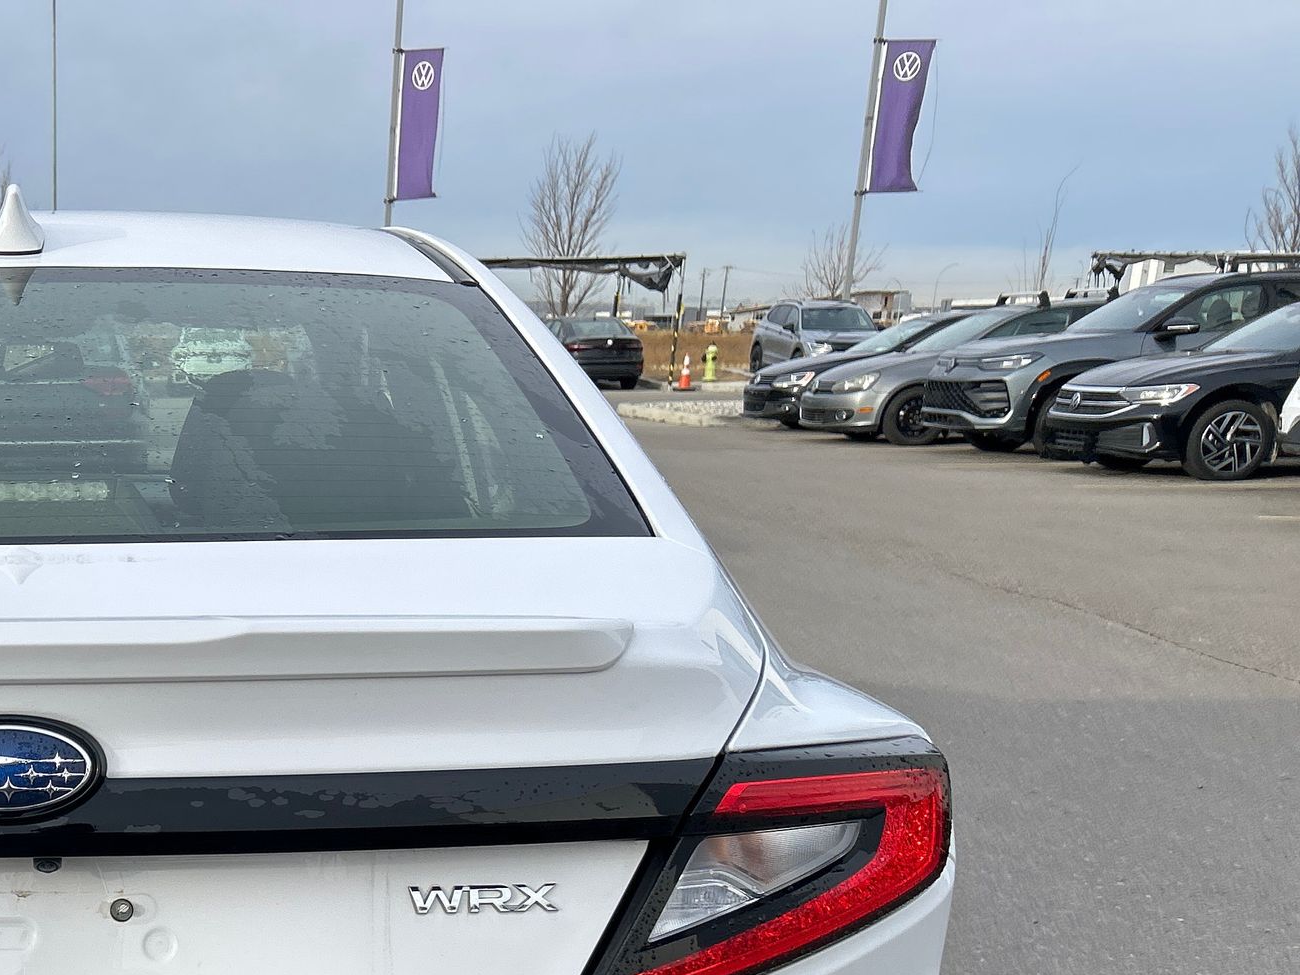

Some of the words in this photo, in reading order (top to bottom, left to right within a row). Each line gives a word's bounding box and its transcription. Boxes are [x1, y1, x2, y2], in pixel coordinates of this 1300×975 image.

[412, 61, 435, 90] VW
[893, 51, 921, 82] VW
[407, 882, 559, 914] WRX
